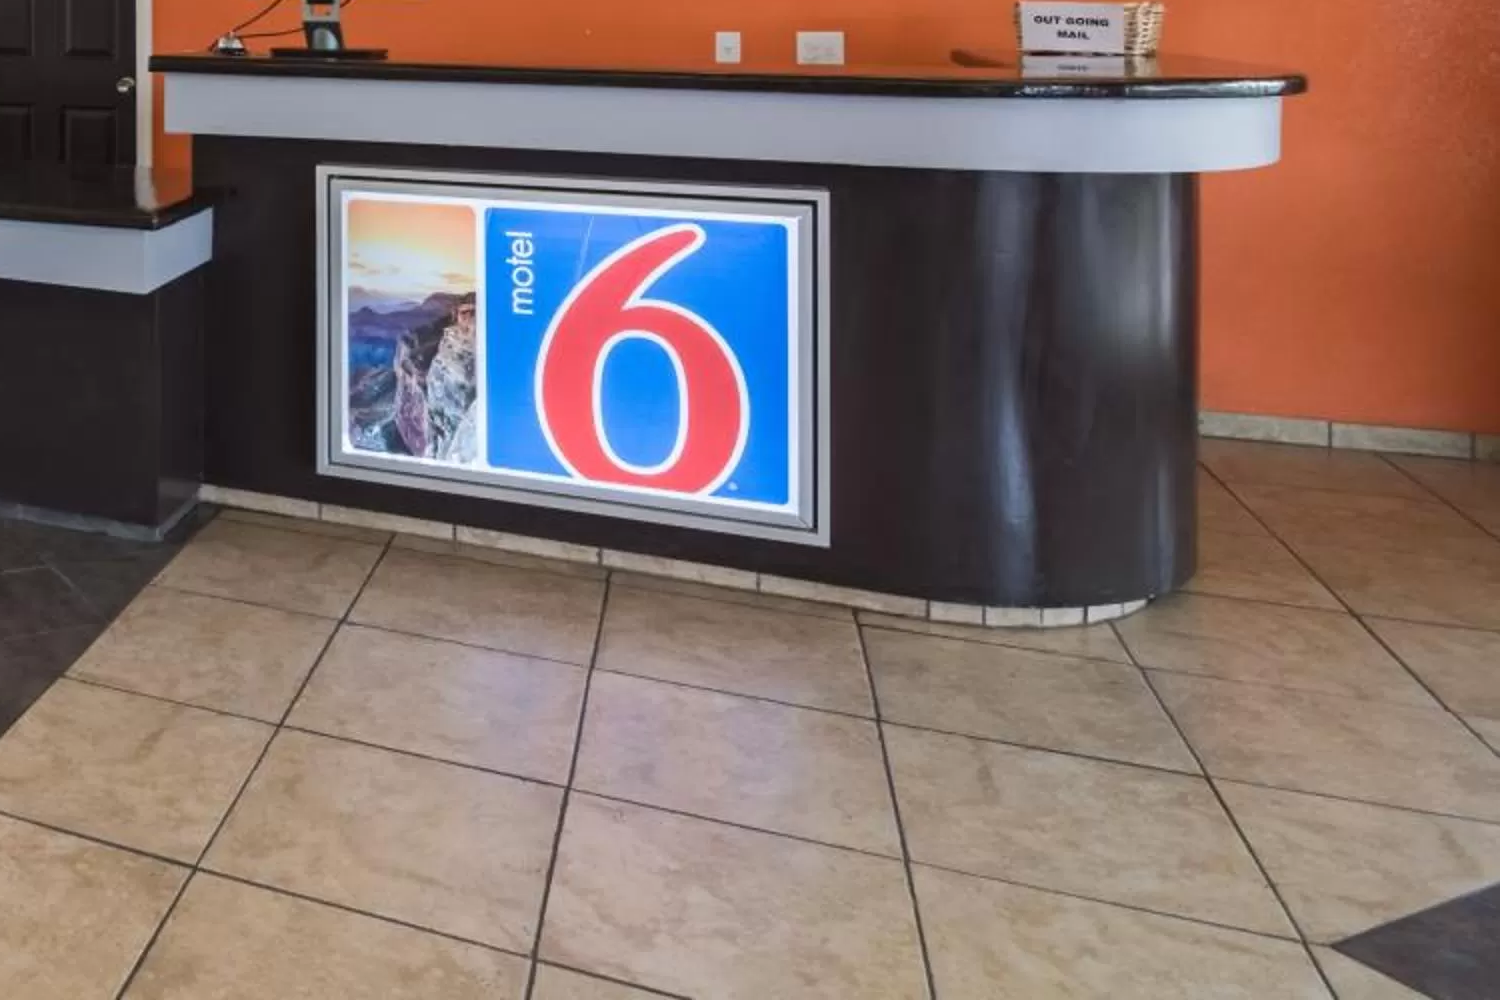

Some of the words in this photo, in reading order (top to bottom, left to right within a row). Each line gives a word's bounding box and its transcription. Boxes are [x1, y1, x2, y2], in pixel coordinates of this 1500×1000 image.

[1033, 15, 1061, 25] OUT
[1065, 17, 1109, 27] GOING
[1057, 30, 1090, 40] MAIL
[506, 231, 534, 316] motel
[534, 223, 750, 496] 6
